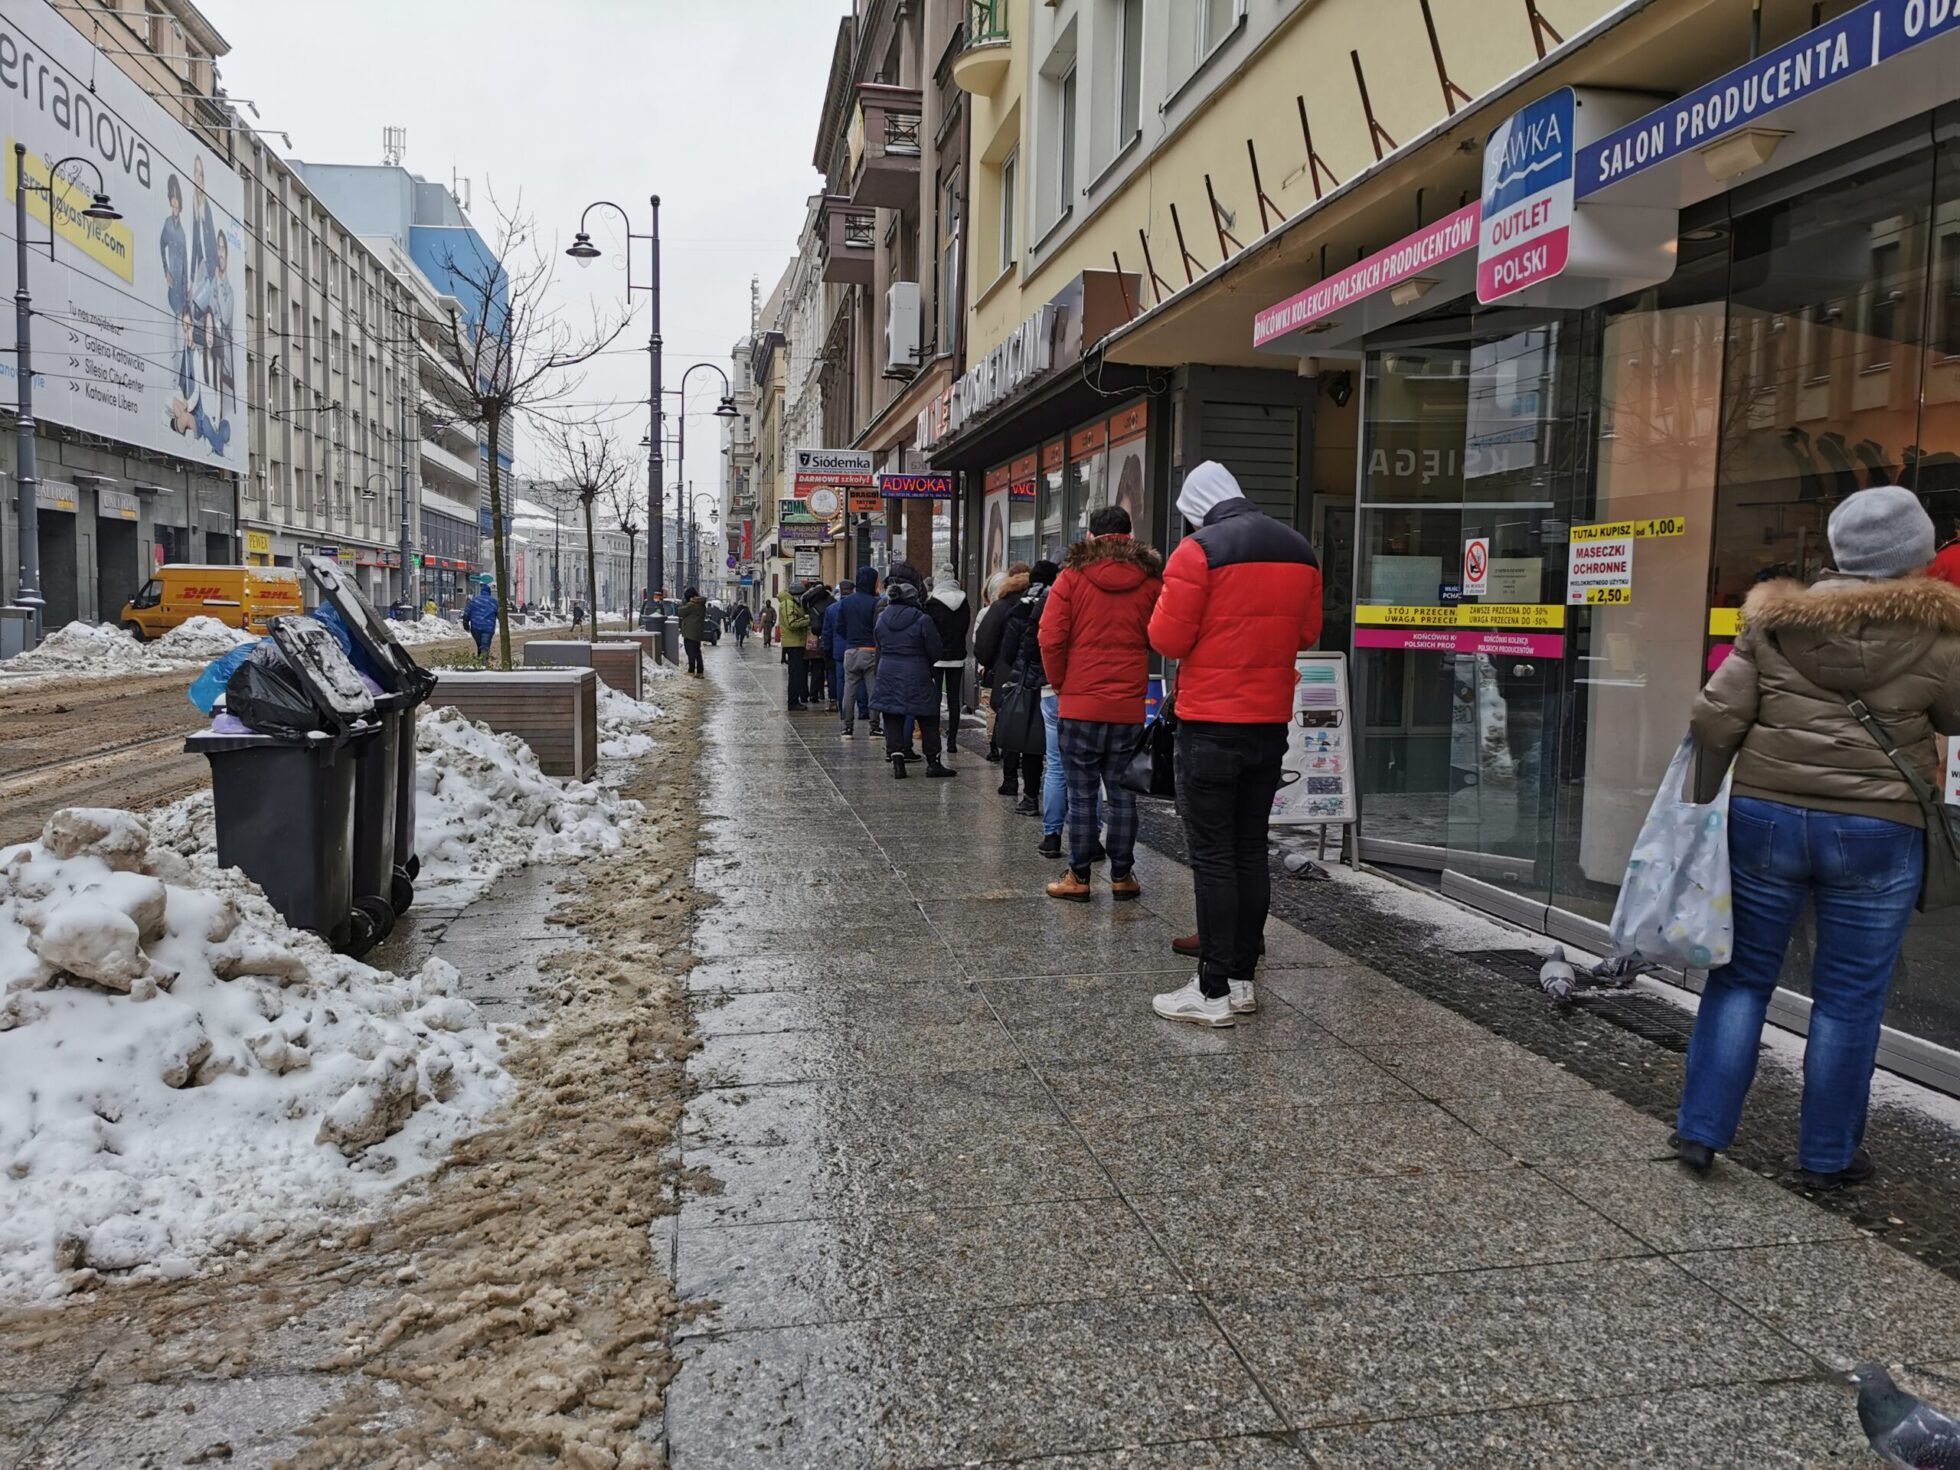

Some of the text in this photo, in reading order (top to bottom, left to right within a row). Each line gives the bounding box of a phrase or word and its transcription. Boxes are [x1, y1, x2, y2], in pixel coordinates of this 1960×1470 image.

[1599, 31, 1850, 182] SALON PRODUCENTA
[1489, 113, 1562, 181] SAWKA
[1492, 197, 1552, 245] OUTLET
[1291, 286, 1332, 325] KOLEKCJI
[1332, 261, 1381, 305] POLSKICH
[1382, 214, 1474, 282] PRODUCENTÓW
[1494, 245, 1547, 289] POLSKI
[85, 335, 145, 372] Galeria Katowicka
[85, 358, 144, 393] Silesia City Center
[85, 382, 138, 414] Katowice Libero
[812, 455, 871, 468] Siódemka
[798, 475, 840, 483] DARMOWE
[1573, 519, 1684, 539] TUTAJ KUPISZ od 1,00 zł
[1576, 545, 1625, 559] MASECZKI
[1573, 561, 1627, 575] OCHRONNE
[183, 587, 222, 600] DHL
[259, 591, 291, 600] DHL
[1597, 589, 1621, 604] 2,50
[1387, 606, 1410, 616] STÓJ
[1469, 606, 1548, 616] ZAWSZE PRZECENA DO -50%
[1385, 615, 1416, 623] UWAGA
[1469, 615, 1548, 626] UWAGA PRZECENA DO -50%
[1413, 631, 1449, 640] KOŃCÓWKI
[1477, 644, 1534, 655] POLSKICH PRODUCENTÓW
